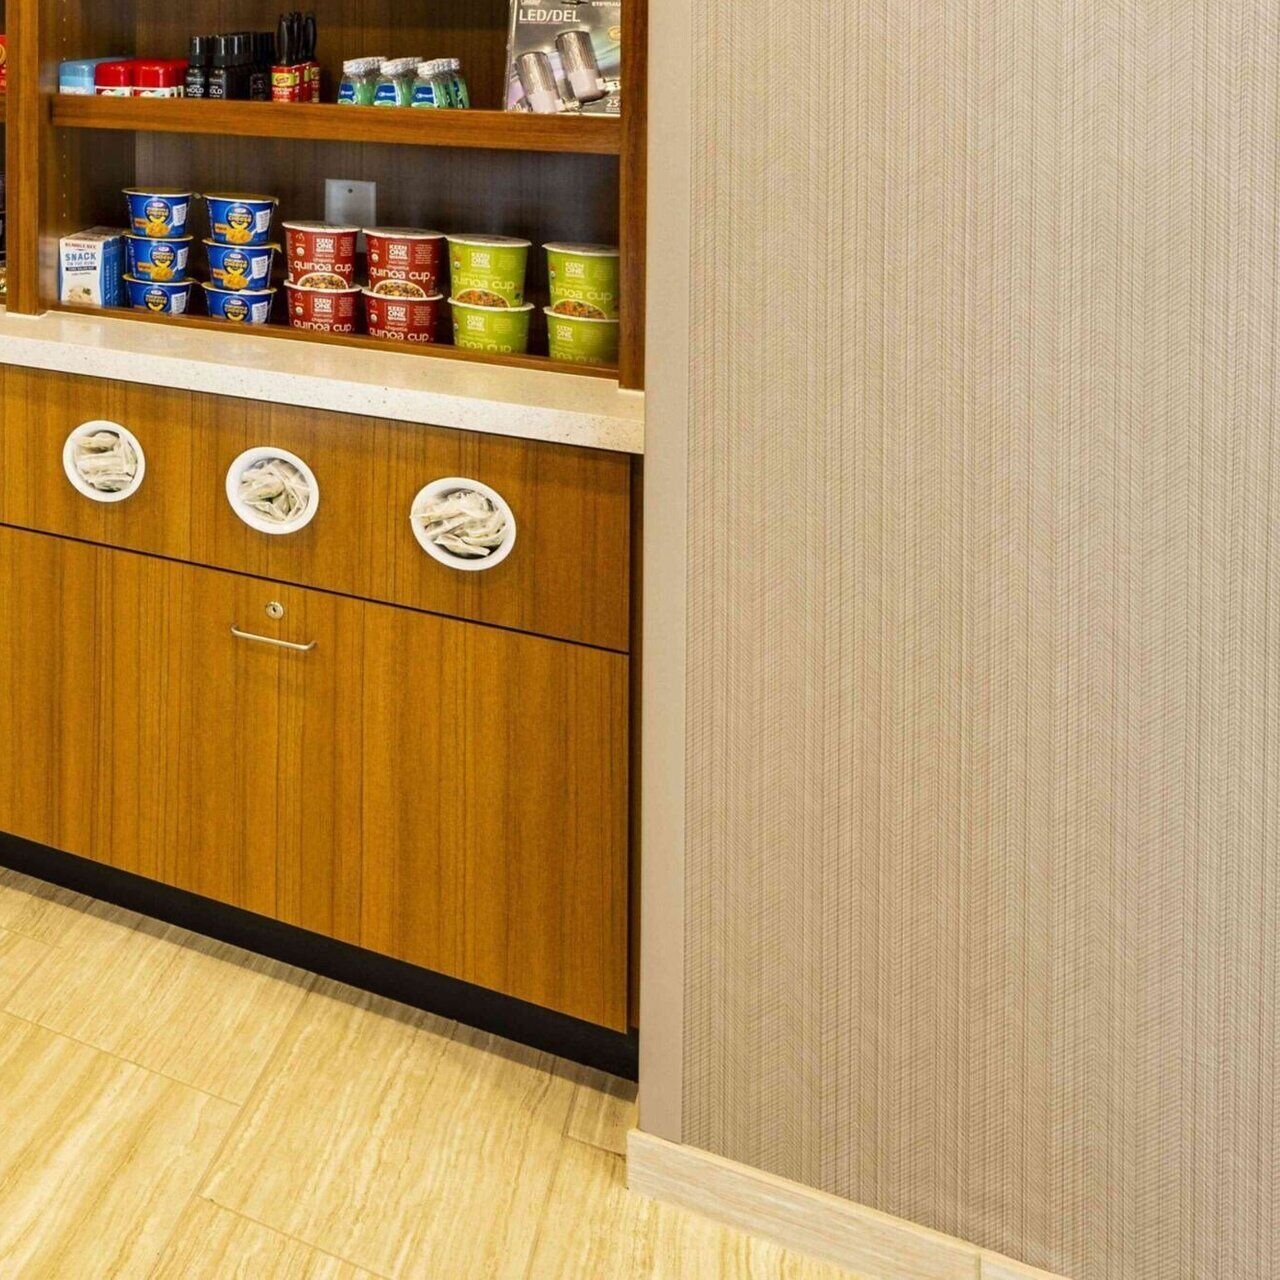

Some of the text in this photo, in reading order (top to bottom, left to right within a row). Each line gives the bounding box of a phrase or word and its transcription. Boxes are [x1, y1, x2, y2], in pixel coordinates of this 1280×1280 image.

[519, 9, 581, 23] LED/DEL
[65, 252, 96, 261] SNACK
[293, 260, 352, 273] quinoa cup
[370, 266, 430, 282] quinoa cup
[492, 279, 515, 292] cup
[587, 290, 612, 302] cup
[293, 319, 351, 333] quinoa cup
[369, 327, 429, 342] quinoa cup
